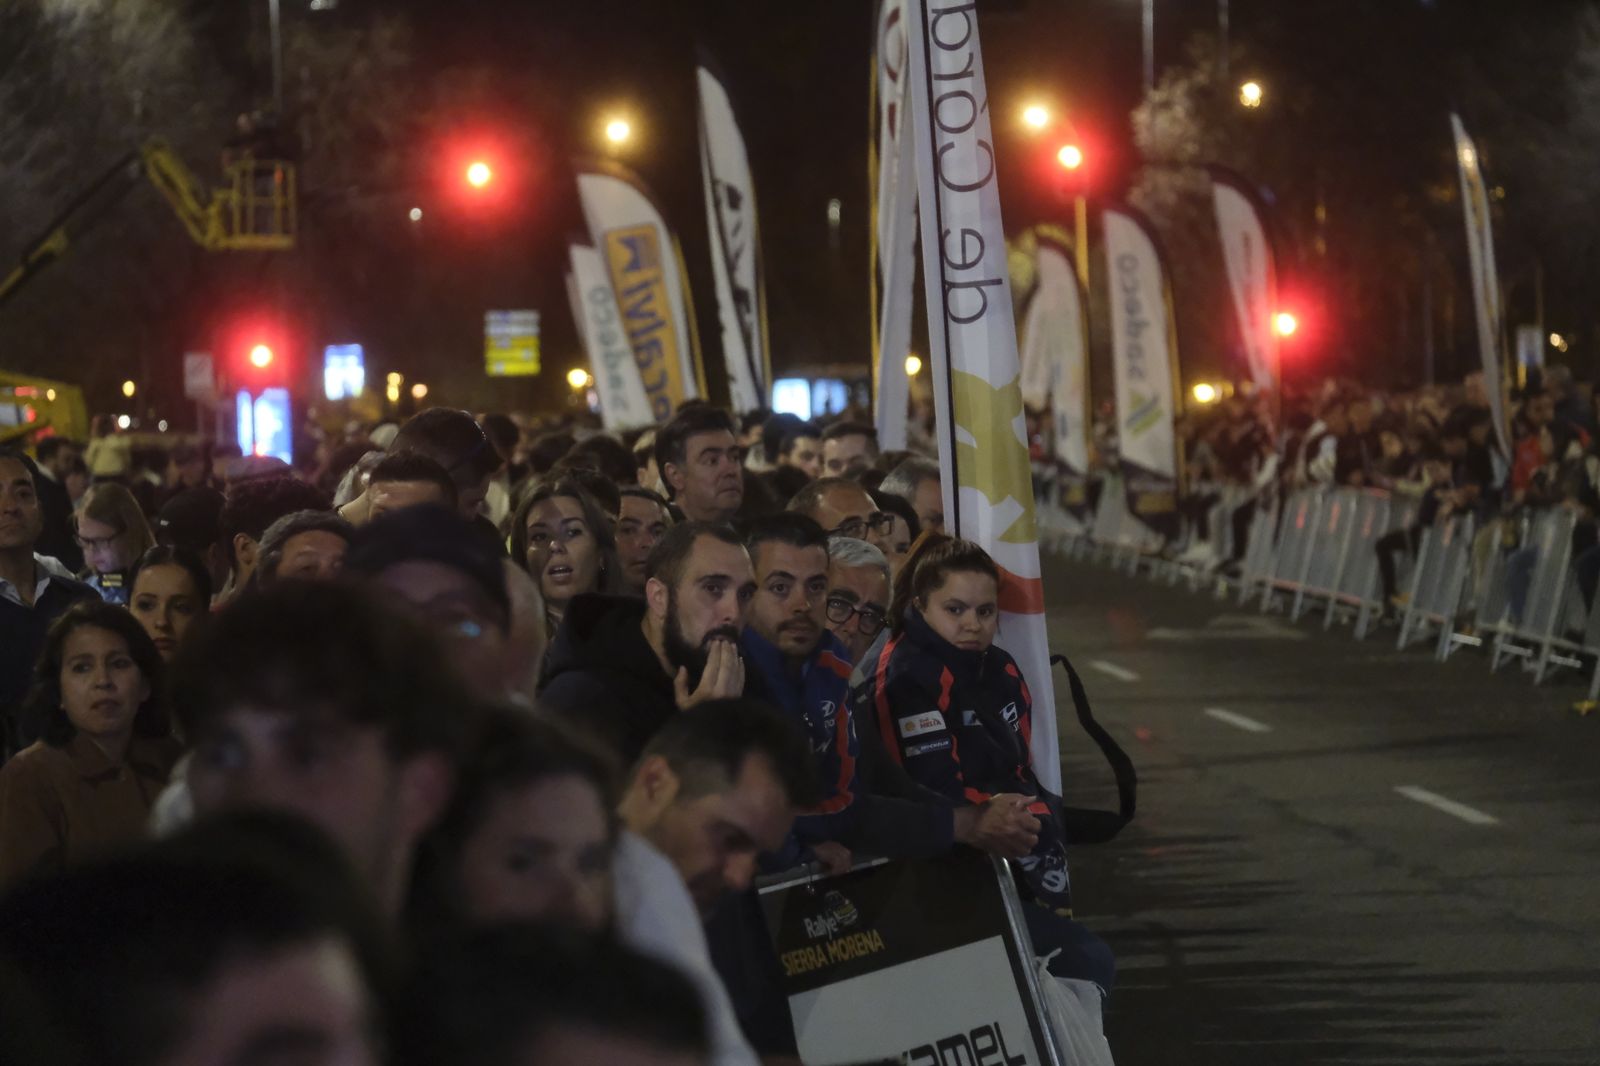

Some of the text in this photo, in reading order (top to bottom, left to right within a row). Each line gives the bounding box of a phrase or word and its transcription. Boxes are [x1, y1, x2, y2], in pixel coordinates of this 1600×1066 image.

[803, 914, 838, 940] Rallye
[781, 928, 886, 976] SIERRA MORENA
